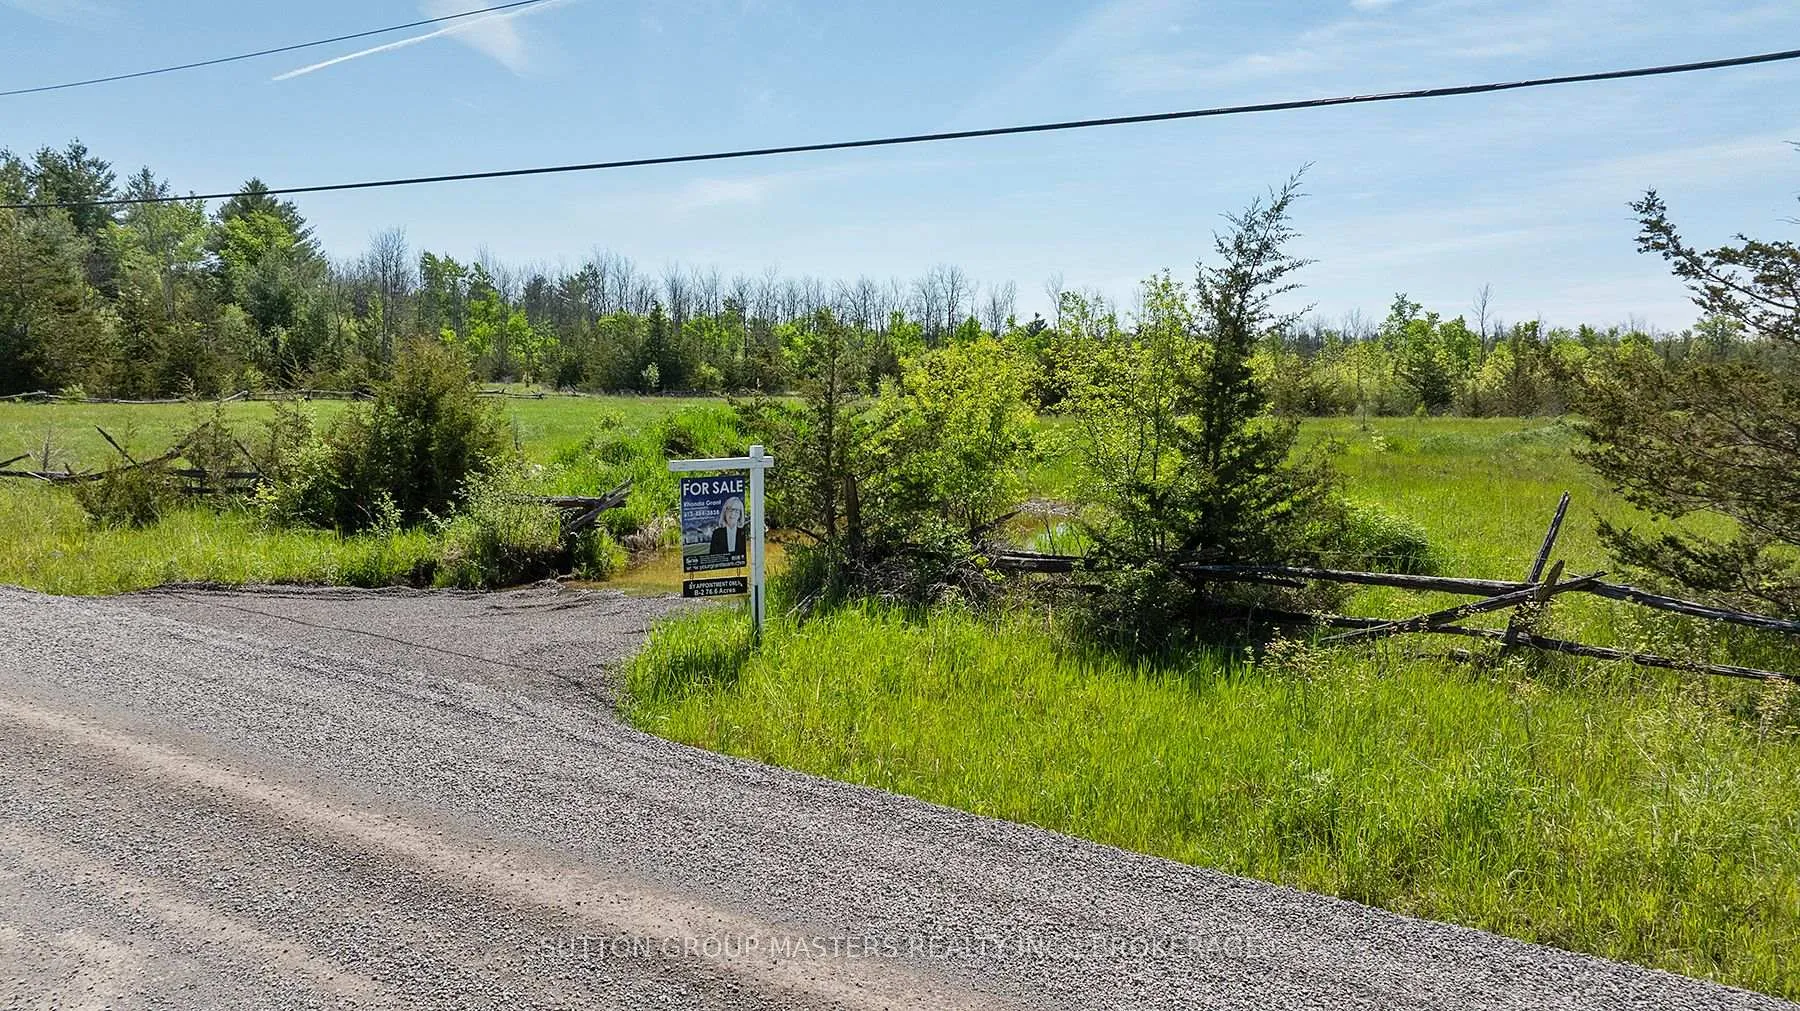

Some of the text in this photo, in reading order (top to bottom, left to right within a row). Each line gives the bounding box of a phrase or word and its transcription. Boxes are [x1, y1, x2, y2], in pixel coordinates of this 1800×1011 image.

[683, 480, 743, 496] FOR SALE
[696, 581, 728, 589] APPOINTMENT
[719, 587, 736, 595] Acres
